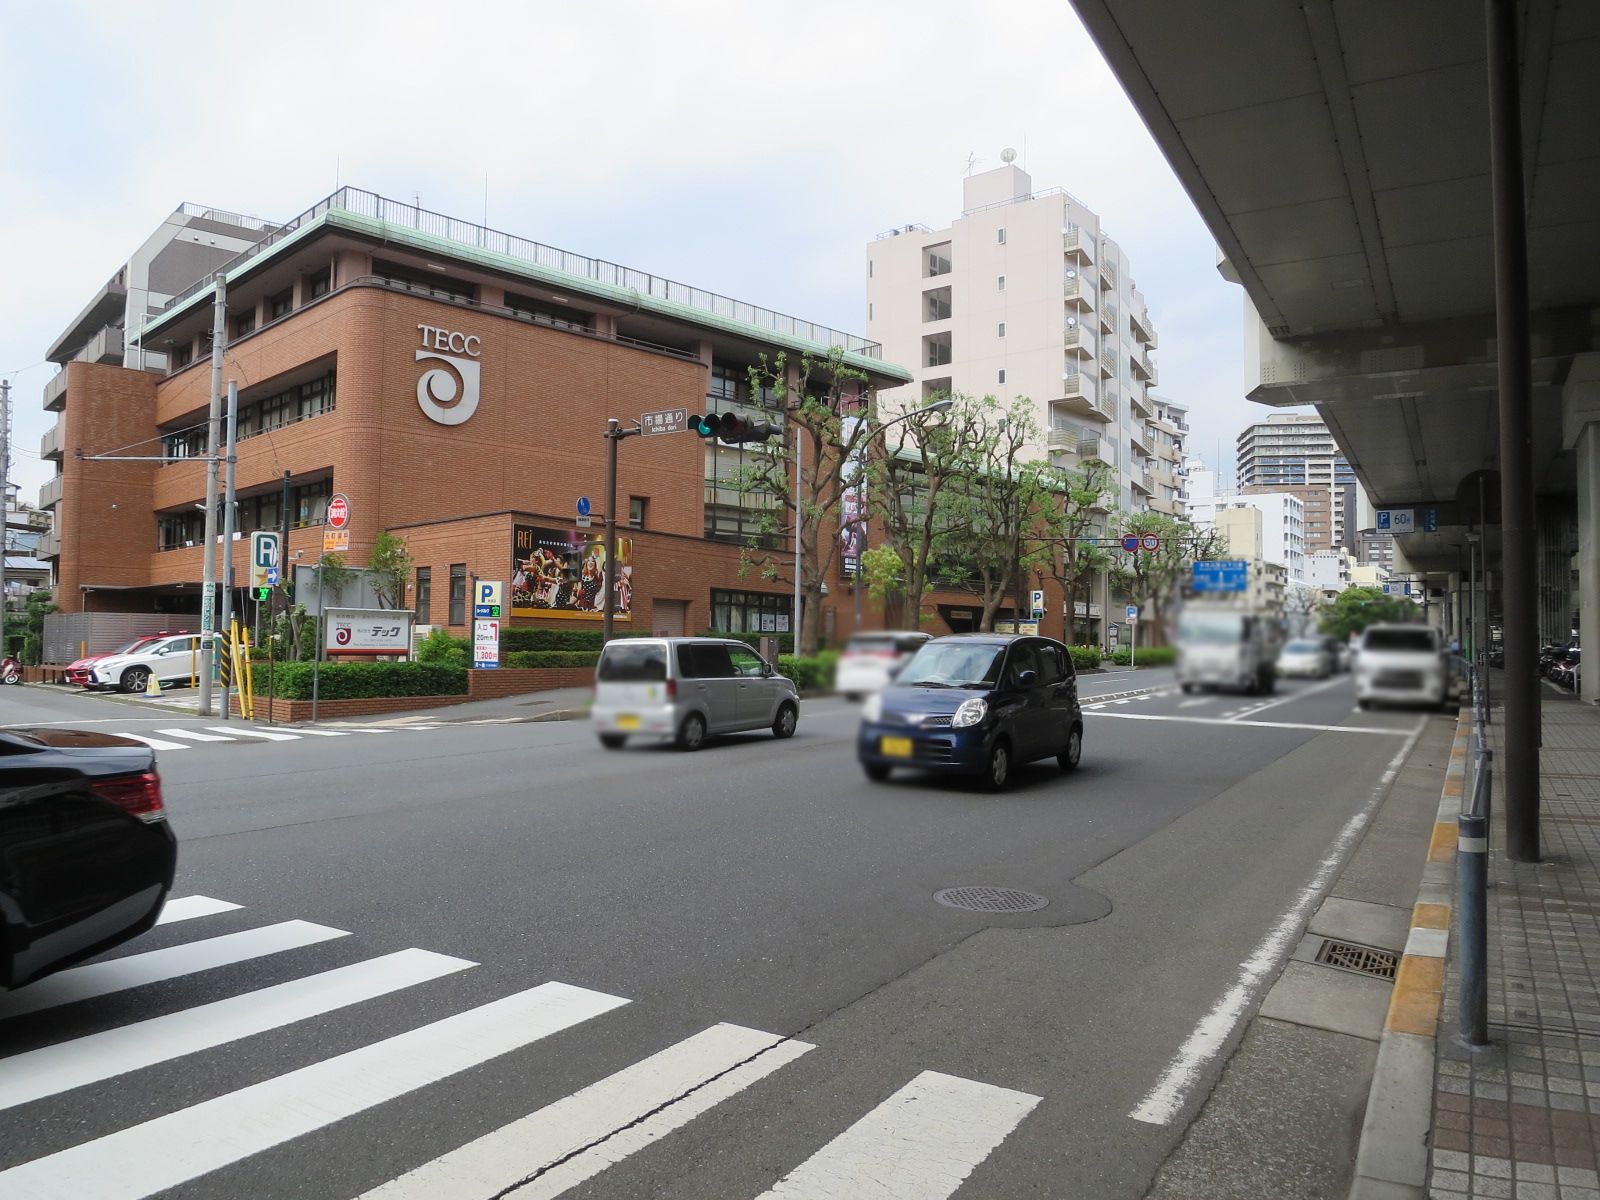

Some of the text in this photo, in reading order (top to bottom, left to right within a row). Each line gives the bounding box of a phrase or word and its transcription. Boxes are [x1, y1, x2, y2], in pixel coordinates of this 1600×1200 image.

[417, 323, 480, 357] TECC
[644, 411, 683, 426] 市場通り
[1380, 512, 1388, 523] P
[1145, 539, 1156, 547] 50
[481, 585, 494, 603] P
[1034, 592, 1041, 603] P
[371, 626, 401, 637] テック
